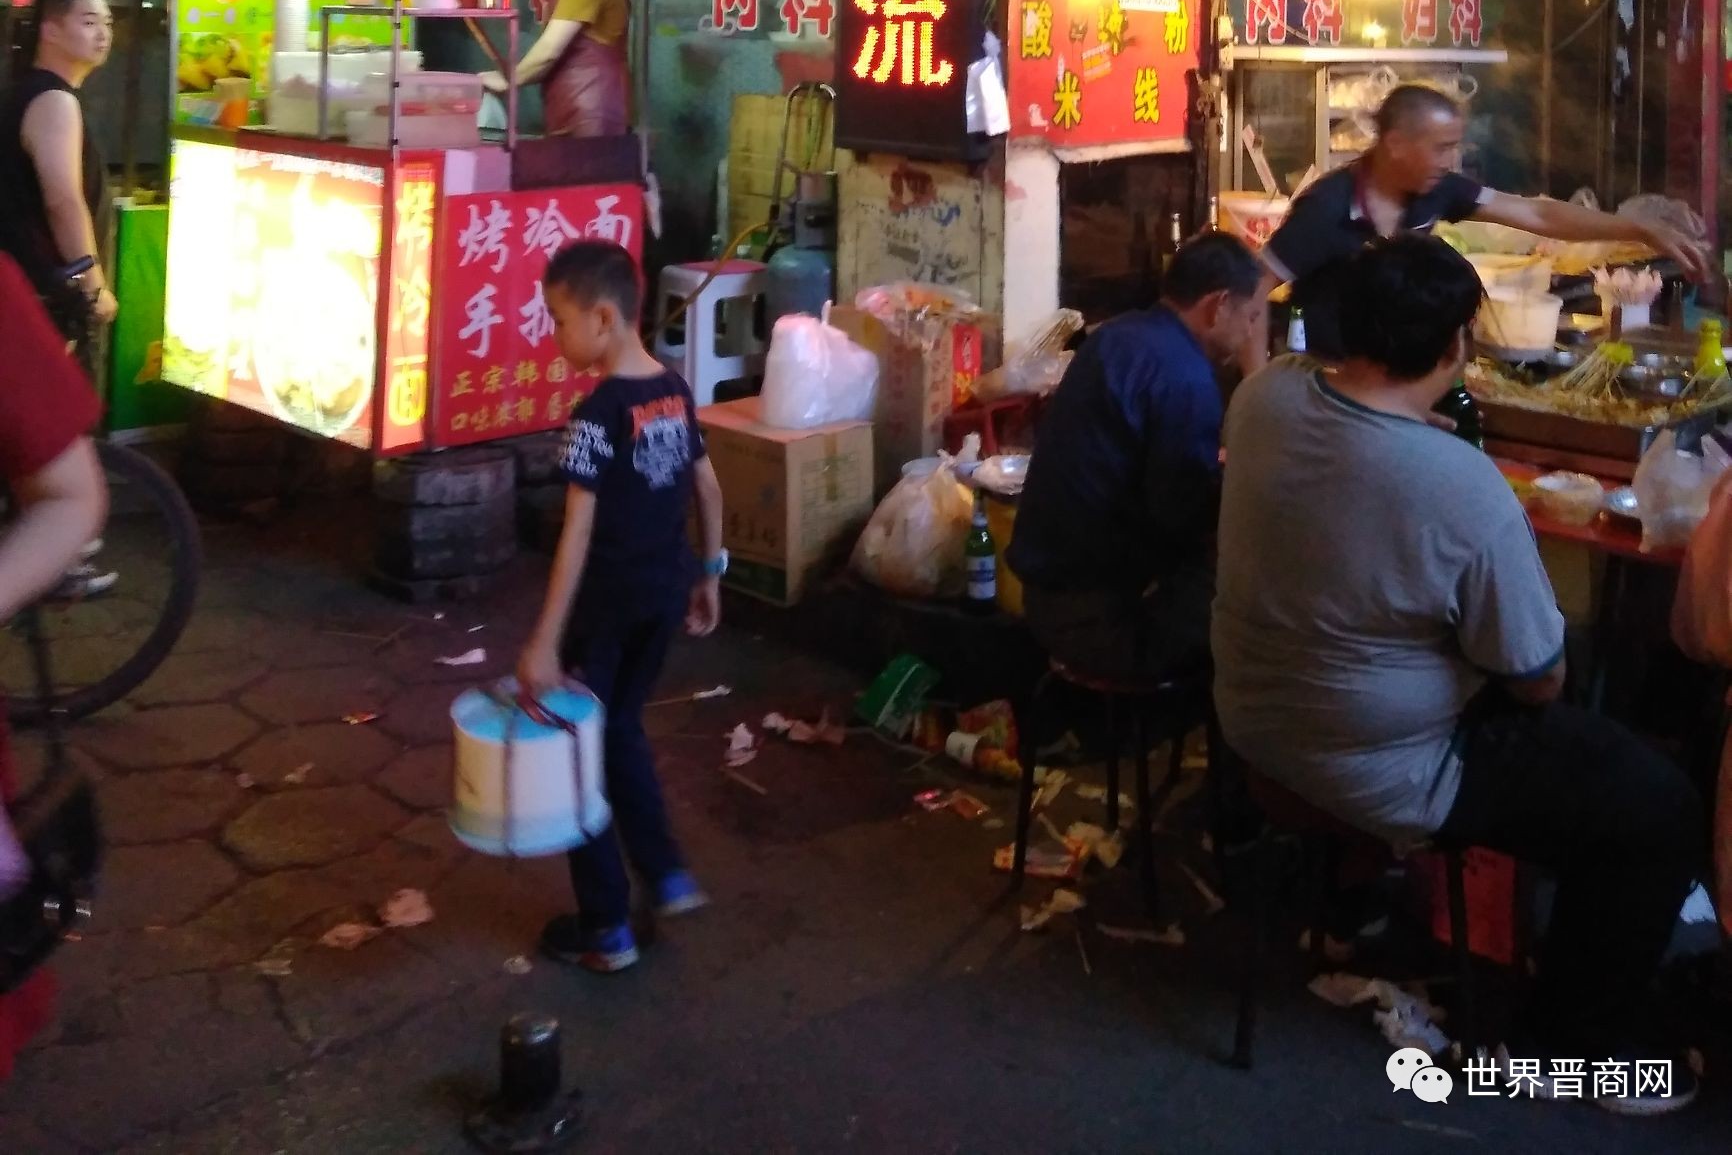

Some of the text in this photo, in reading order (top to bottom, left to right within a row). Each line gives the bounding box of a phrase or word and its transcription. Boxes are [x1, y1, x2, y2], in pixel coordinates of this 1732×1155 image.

[1052, 66, 1160, 132] 米线
[457, 194, 633, 275] 烤冷面
[450, 355, 602, 398] 正宗韩国
